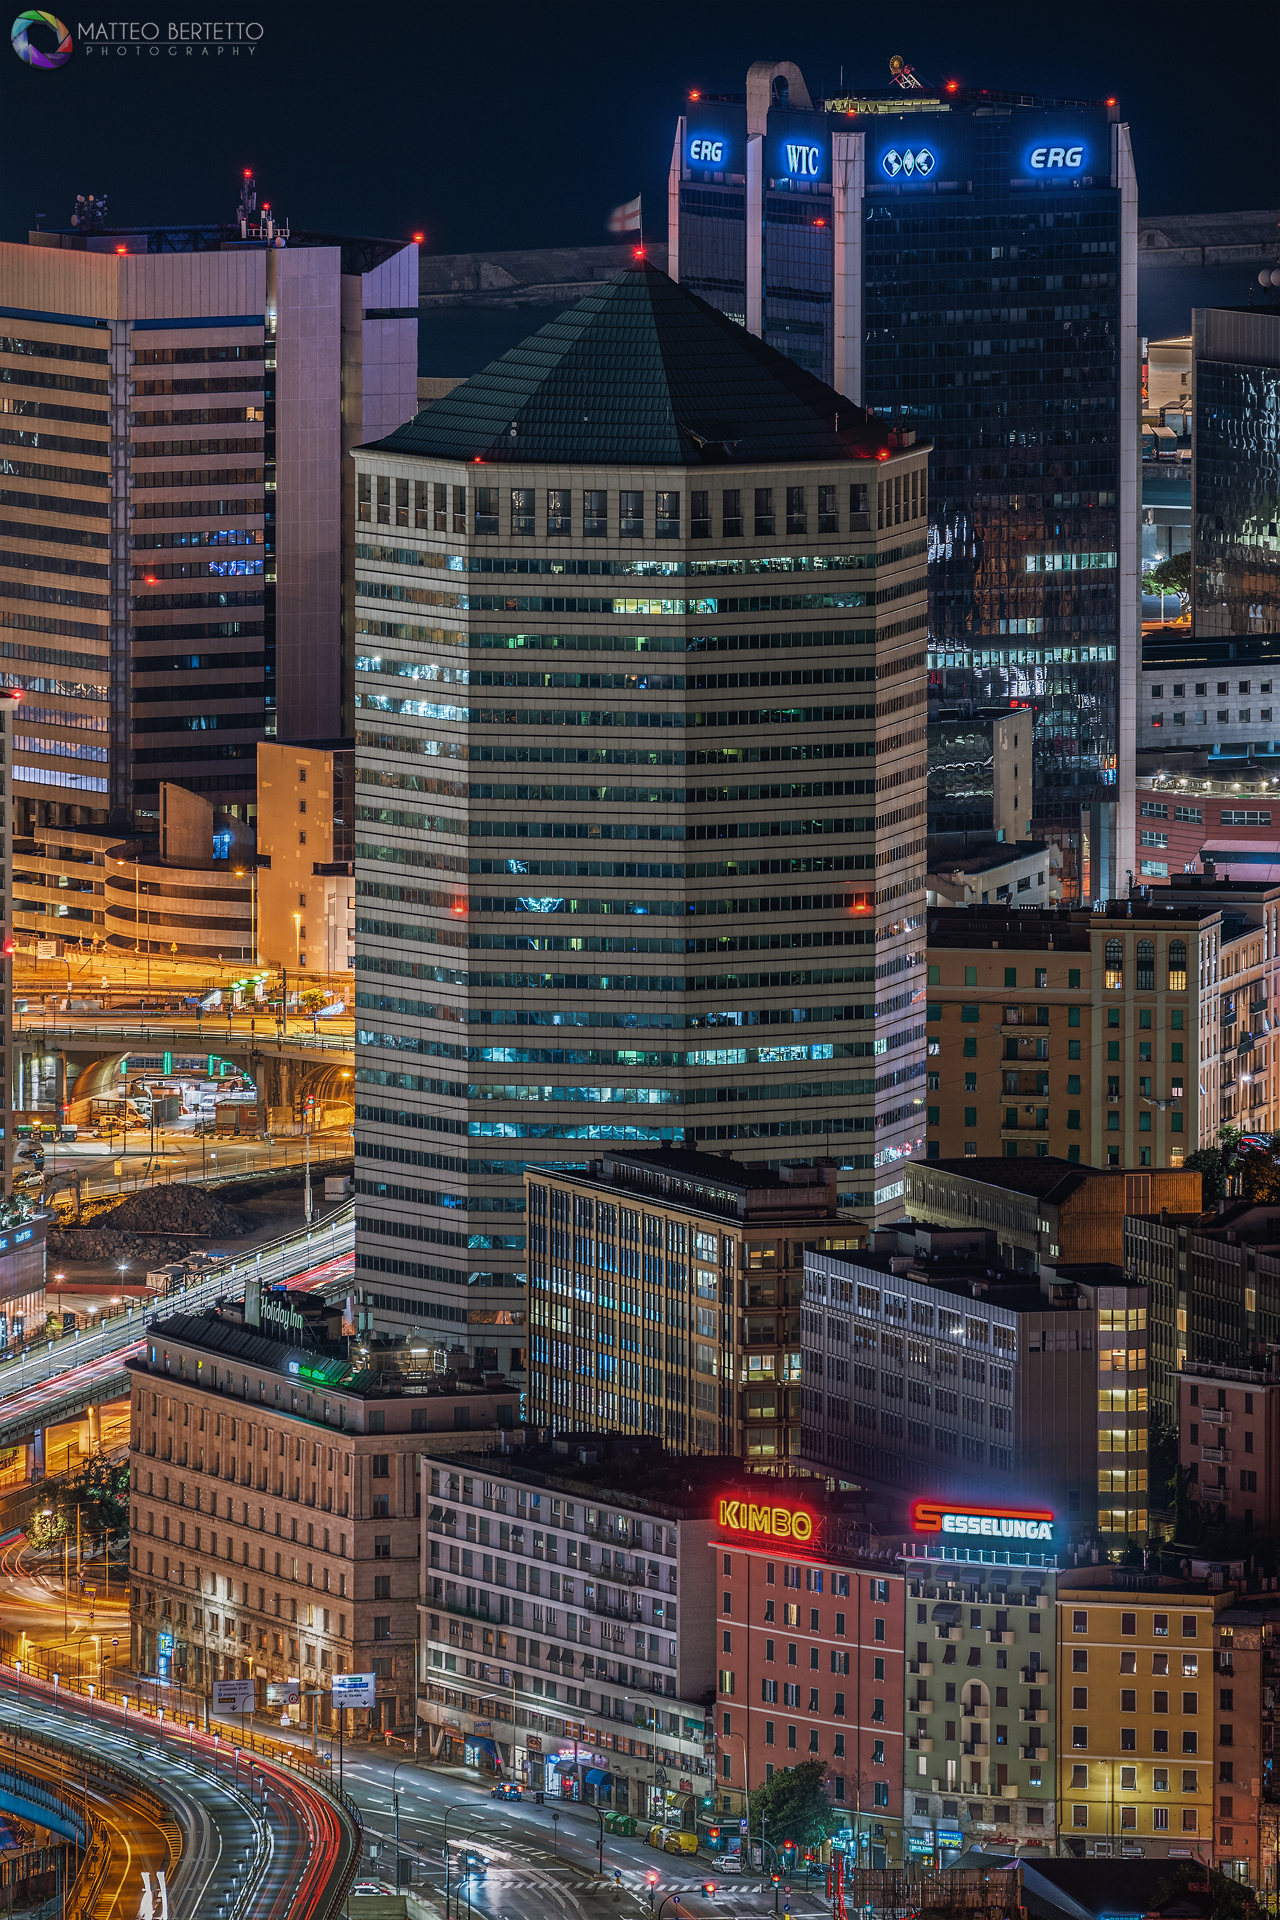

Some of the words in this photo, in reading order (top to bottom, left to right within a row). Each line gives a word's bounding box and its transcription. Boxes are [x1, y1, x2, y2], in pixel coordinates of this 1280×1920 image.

[690, 139, 723, 162] ERG
[786, 143, 819, 176] WTC
[1030, 146, 1083, 169] ERG
[260, 1296, 291, 1331] Holiday
[290, 1304, 304, 1330] Inn
[719, 1499, 812, 1541] KIMBO
[942, 1514, 1053, 1541] ESSELUNGA
